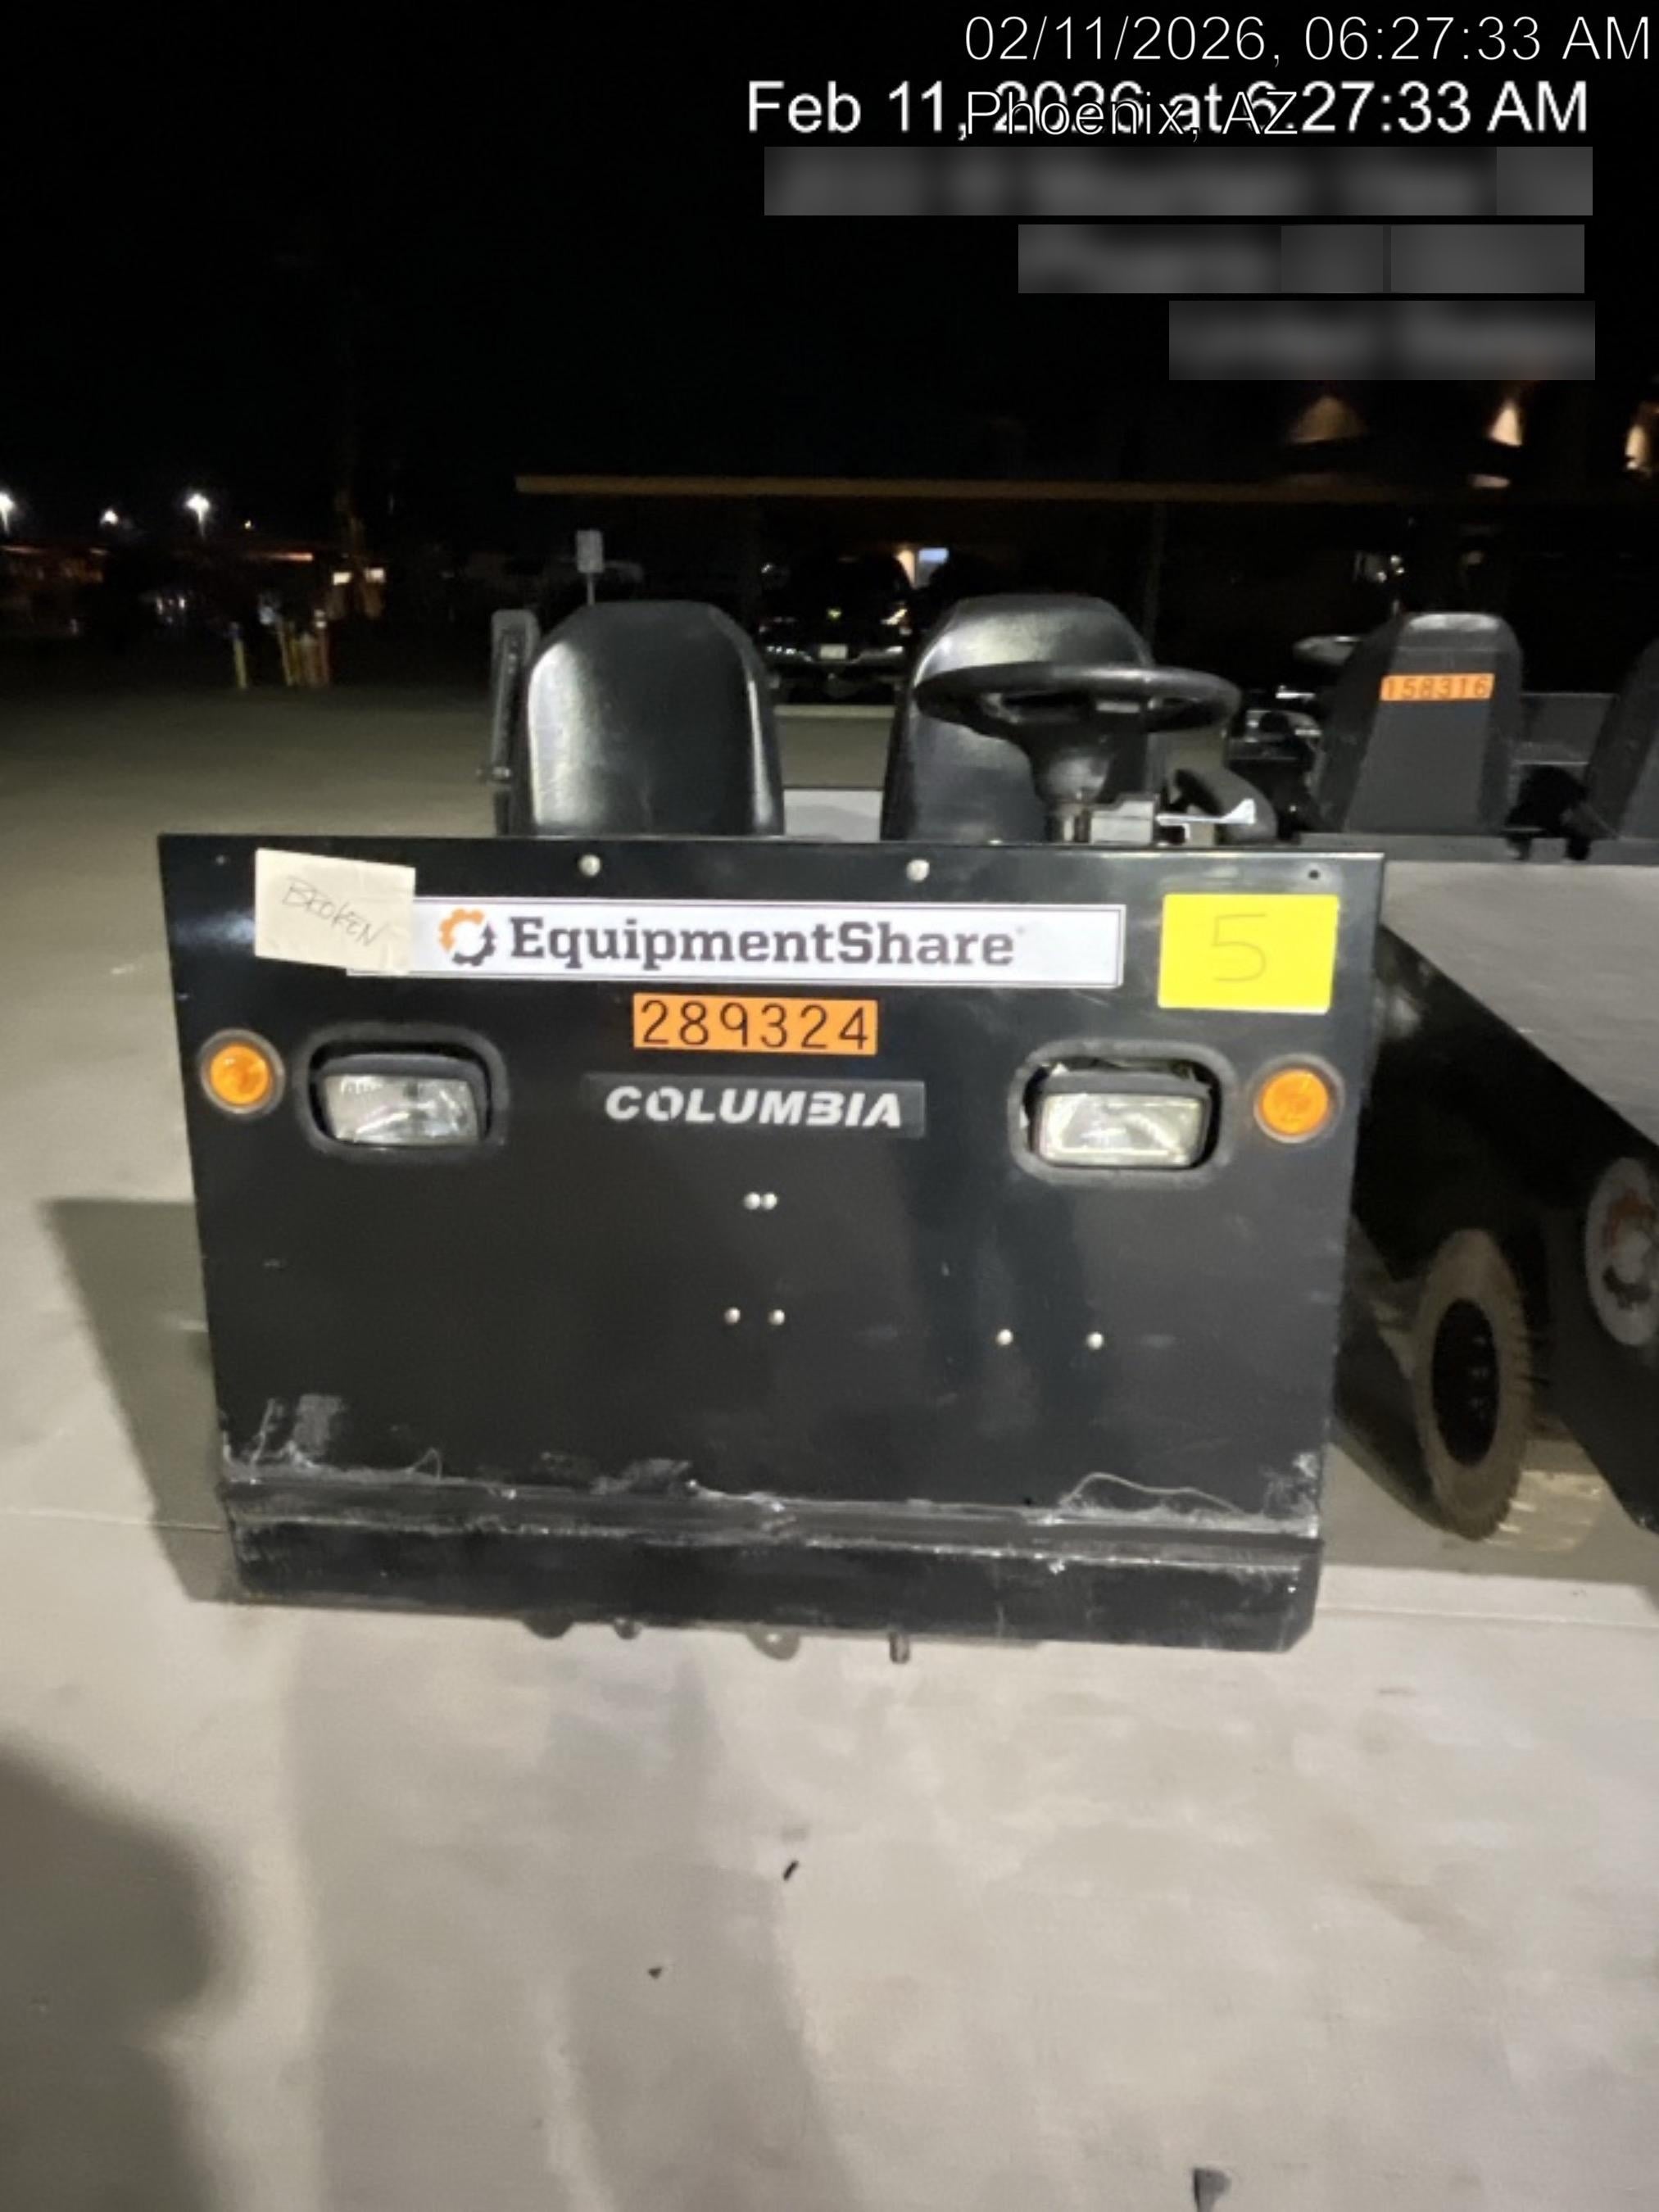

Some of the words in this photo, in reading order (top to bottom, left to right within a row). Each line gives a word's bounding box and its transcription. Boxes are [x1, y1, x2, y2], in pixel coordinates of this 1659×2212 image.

[1387, 676, 1489, 699] 158316
[509, 916, 1015, 971] EquipmentShare
[1210, 912, 1267, 982] 5
[640, 999, 870, 1050] 289324
[605, 1086, 902, 1130] COLUMBIA
